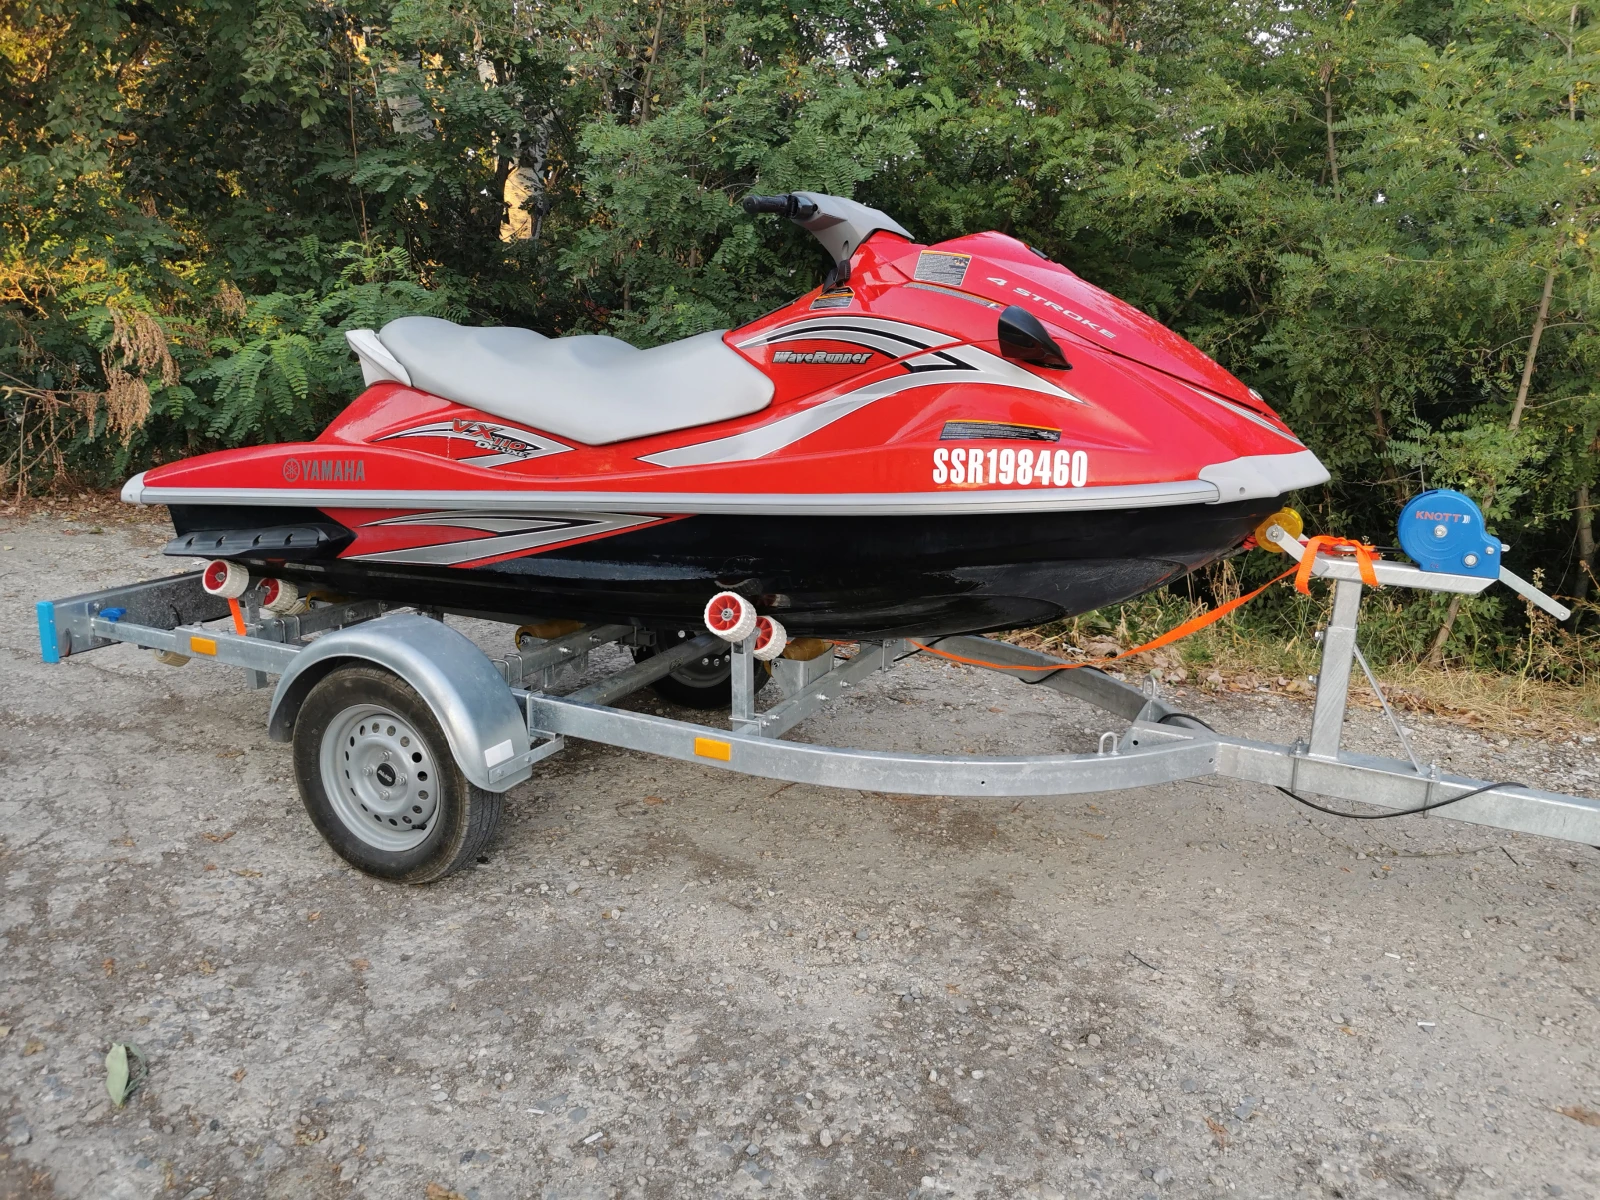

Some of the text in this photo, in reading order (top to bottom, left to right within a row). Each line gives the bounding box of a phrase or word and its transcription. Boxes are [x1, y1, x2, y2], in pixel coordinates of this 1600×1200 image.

[986, 276, 1008, 286] 4
[1012, 287, 1117, 339] STROKE
[772, 350, 874, 365] WaveRunner
[301, 459, 366, 482] YAMAHA
[932, 447, 1088, 488] SSR198460
[1415, 510, 1462, 523] KNOTT
